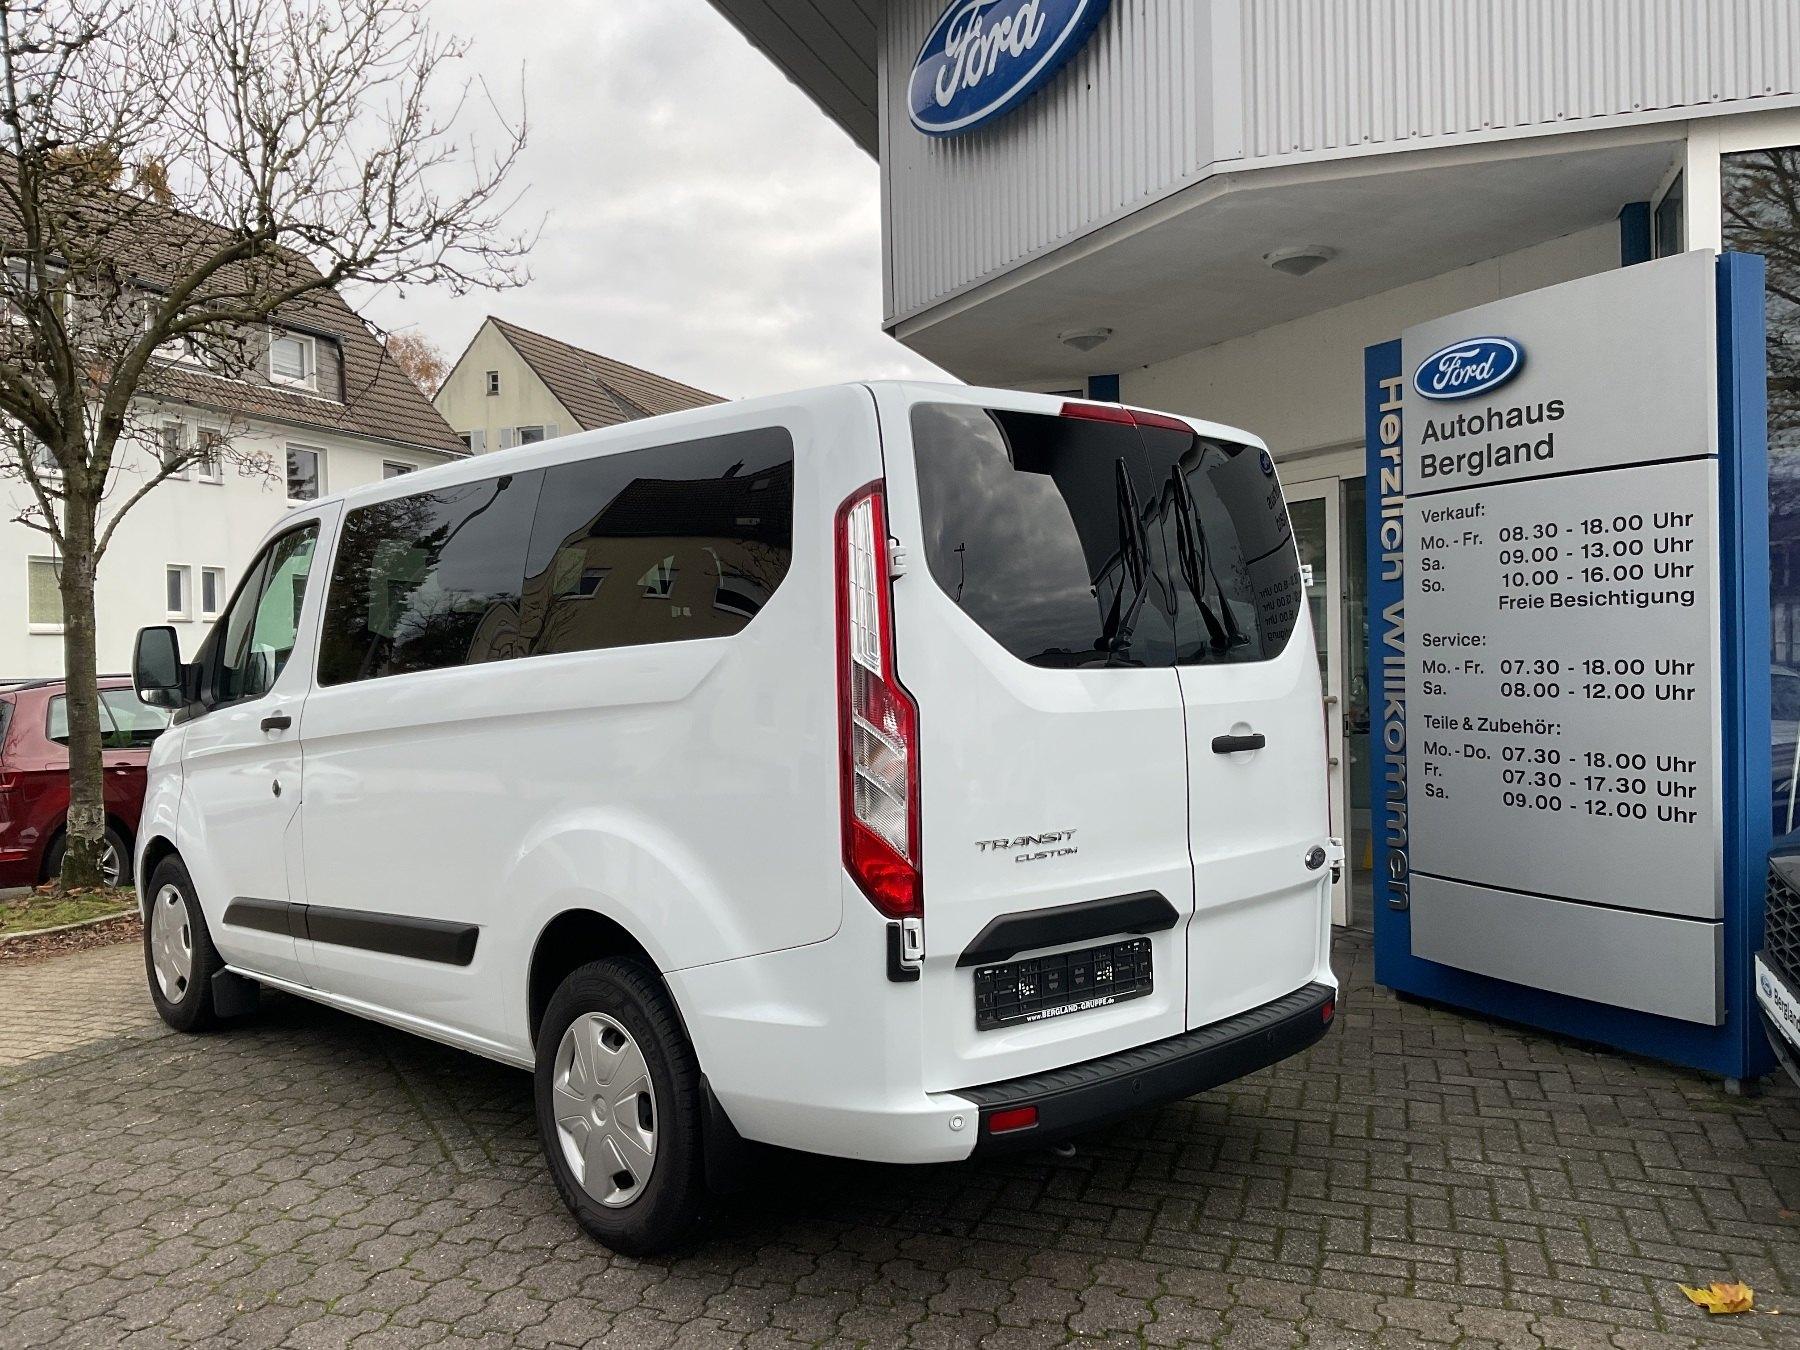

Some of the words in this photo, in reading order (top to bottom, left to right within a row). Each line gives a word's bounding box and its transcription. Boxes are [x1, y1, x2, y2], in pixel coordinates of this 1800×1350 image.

[935, 0, 1046, 108] Ford
[1432, 347, 1496, 390] Ford
[1421, 399, 1565, 445] Autohaus
[1420, 432, 1554, 479] Bergland
[1379, 375, 1405, 582] Herzlich
[1421, 502, 1485, 524] Verkauf:
[1421, 535, 1449, 551] Mo.
[1462, 531, 1483, 546] Fr.
[1499, 522, 1558, 542] 08.30
[1580, 514, 1643, 535] 18.00
[1653, 511, 1694, 529] Uhr
[1421, 557, 1445, 571] Sa.
[1499, 546, 1558, 565] 09.00
[1580, 539, 1644, 559] 13.00
[1653, 536, 1694, 554] Uhr
[1421, 578, 1445, 593] So.
[1501, 569, 1559, 588] 10.00
[1580, 564, 1644, 583] 16.00
[1654, 562, 1694, 579] Uhr
[1499, 594, 1545, 610] Freie
[1550, 589, 1695, 609] Besichtigung
[1422, 632, 1486, 647] Service:
[1422, 660, 1451, 674] Mo.
[1464, 660, 1484, 674] Fr.
[1500, 659, 1560, 675] 07.30
[1582, 659, 1645, 676] 18.00
[1654, 659, 1695, 676] Uhr
[1423, 681, 1447, 695] Sa.
[1500, 682, 1560, 698] 08.00
[1582, 683, 1645, 700] 12.00
[1655, 684, 1696, 701] Uhr
[1424, 714, 1459, 730] Teile
[1462, 716, 1473, 731] &
[1477, 717, 1562, 735] Zubehör:
[1382, 599, 1409, 912] Willkommen
[1463, 744, 1491, 760] Do.
[1501, 746, 1561, 765] 07.30
[1583, 751, 1647, 770] 18.00
[1656, 755, 1697, 773] Uhr
[1424, 762, 1442, 777] Fr.
[1502, 769, 1562, 788] 07.30
[1584, 775, 1647, 795] 17.30
[1656, 780, 1697, 798] Uhr
[1424, 783, 1449, 799] Sa.
[1502, 791, 1562, 812] 09.00
[1584, 799, 1647, 820] 12.00
[1657, 805, 1698, 824] Uhr
[975, 828, 1078, 852] TRANSIT
[1014, 846, 1078, 864] CUSTOM
